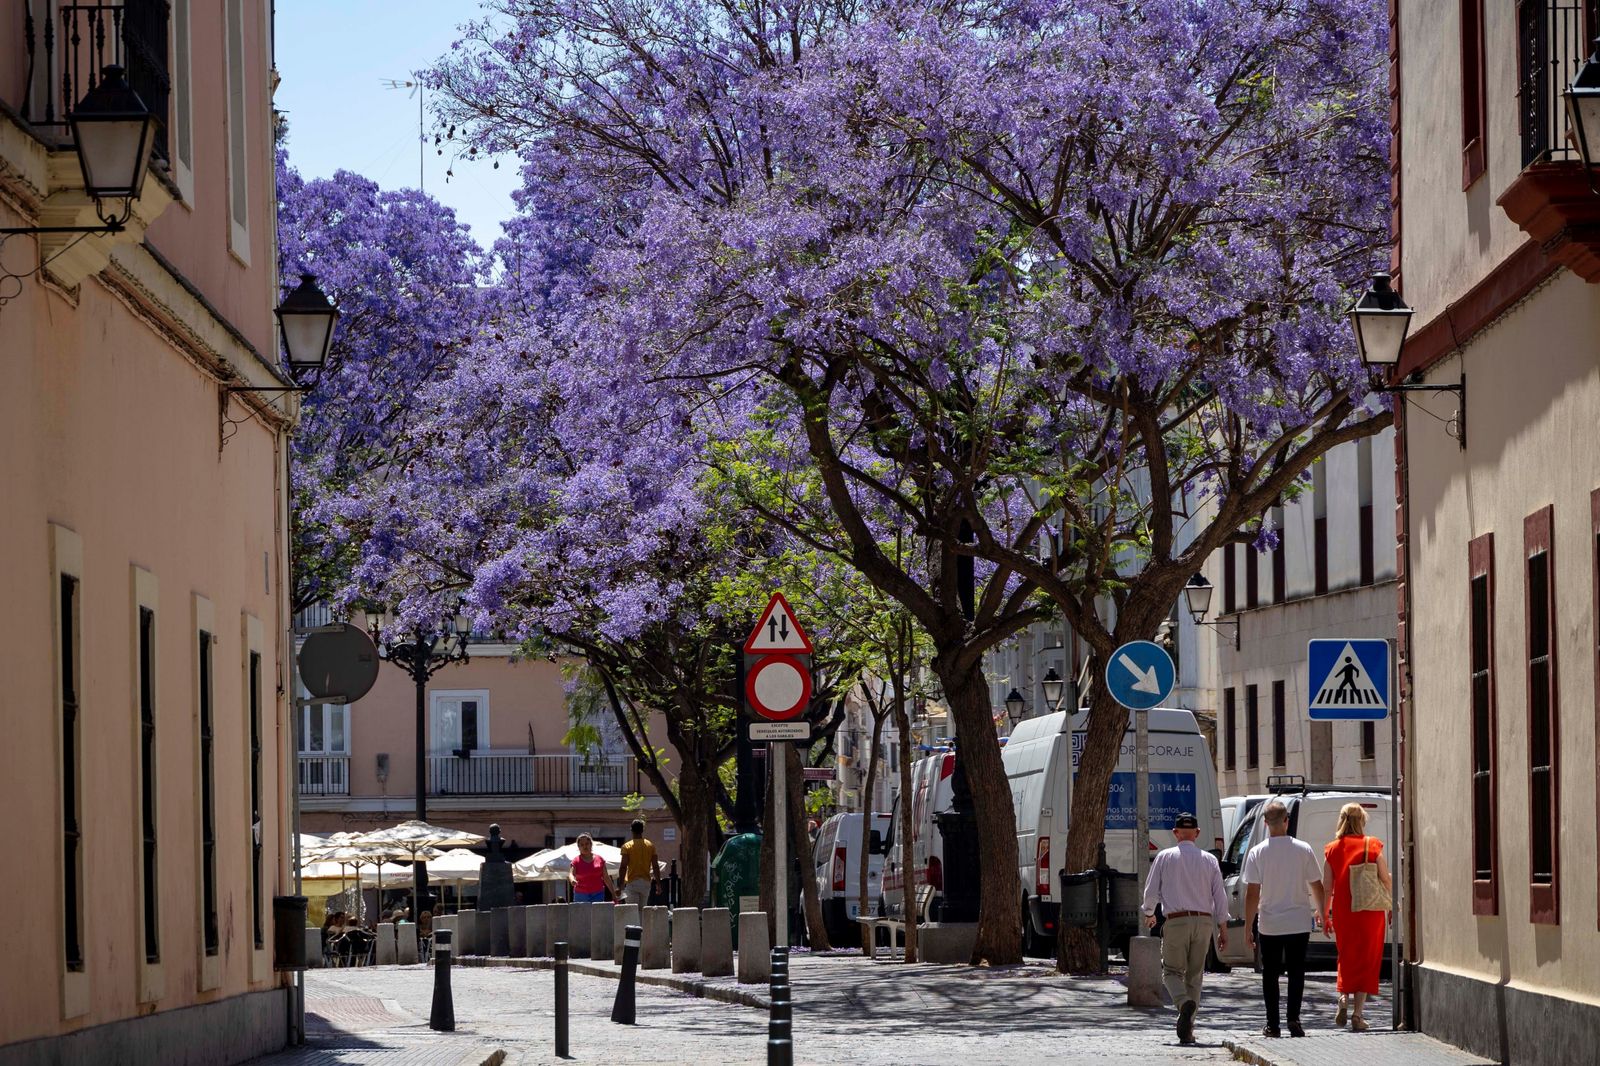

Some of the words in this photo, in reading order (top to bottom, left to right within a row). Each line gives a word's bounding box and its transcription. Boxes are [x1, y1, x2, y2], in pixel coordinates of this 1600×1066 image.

[1147, 745, 1194, 756] CORAJE
[1157, 783, 1173, 792] 114
[1175, 784, 1191, 792] 444
